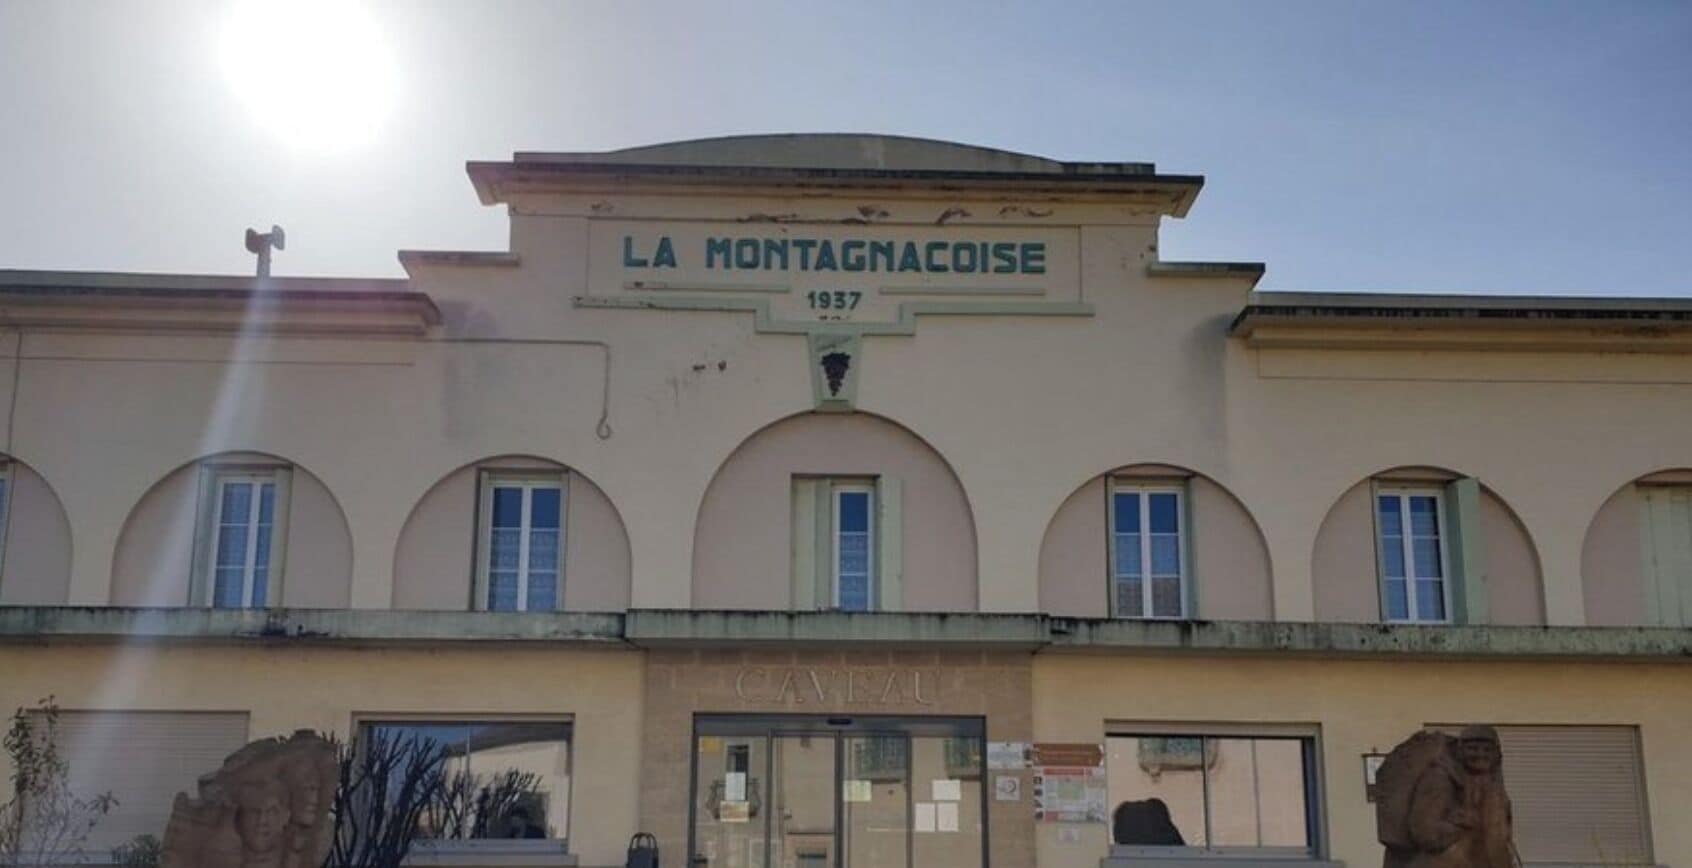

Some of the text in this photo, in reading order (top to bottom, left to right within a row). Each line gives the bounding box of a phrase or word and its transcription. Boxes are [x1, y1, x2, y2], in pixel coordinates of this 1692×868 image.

[623, 236, 1046, 274] LA MONTAGNACOISE
[807, 291, 862, 311] 1937
[735, 667, 938, 706] CAVEAU
